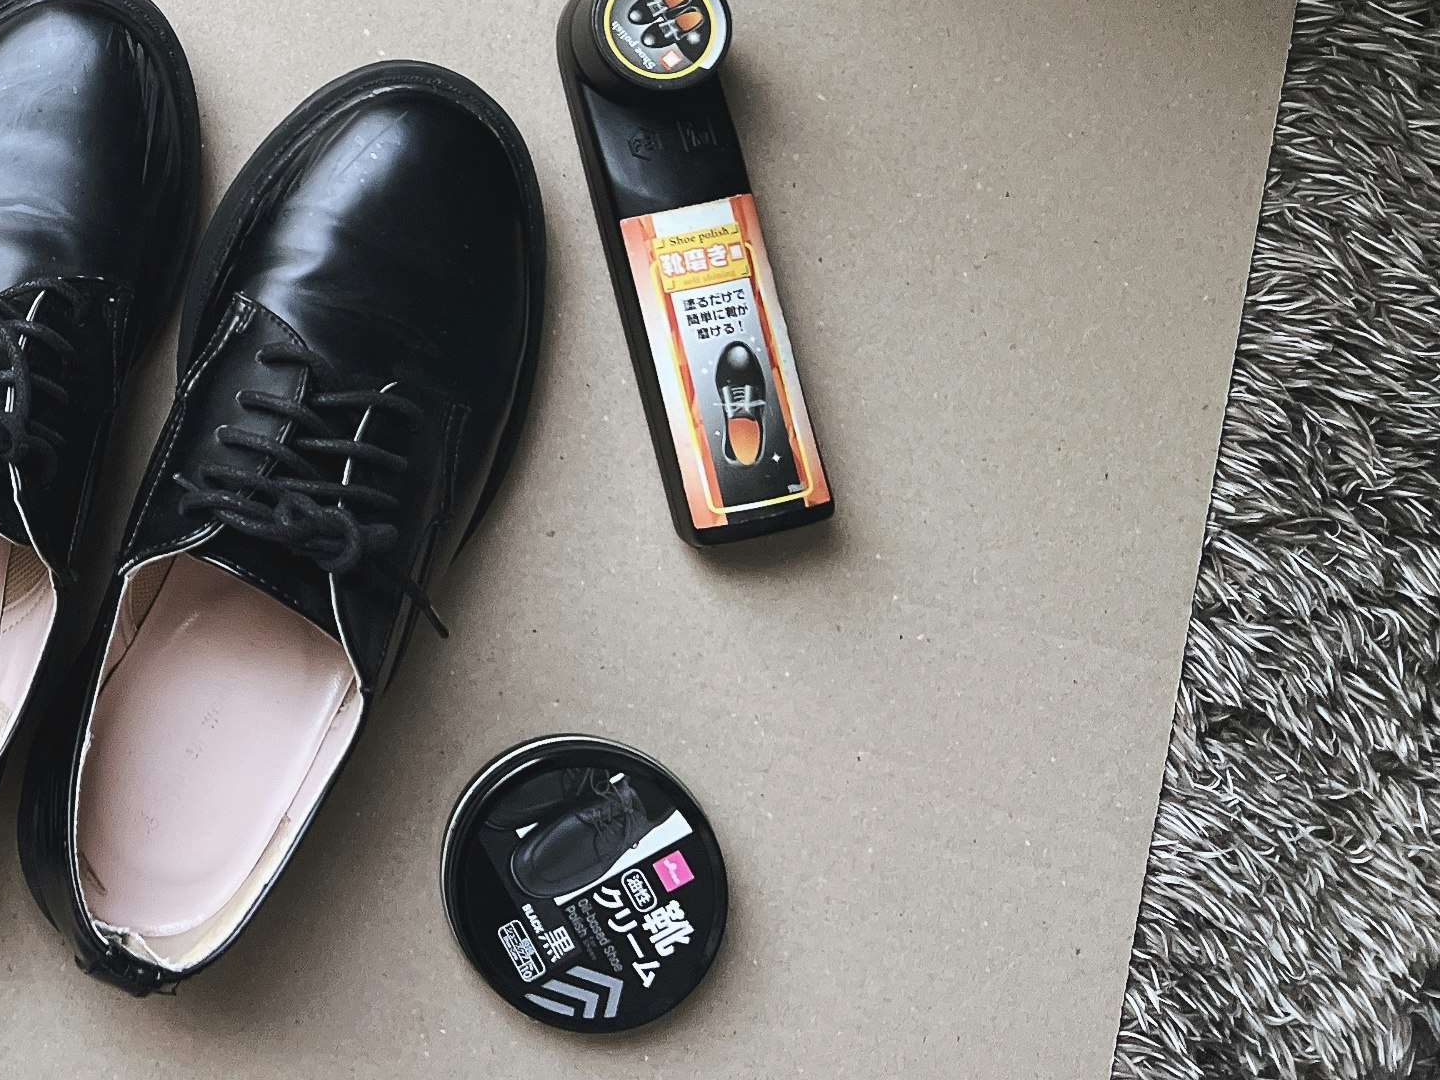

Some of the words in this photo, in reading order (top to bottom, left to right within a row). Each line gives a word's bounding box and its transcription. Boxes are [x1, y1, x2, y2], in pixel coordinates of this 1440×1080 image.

[611, 20, 639, 49] polish
[635, 47, 656, 70] Shoe
[669, 235, 696, 247] Shoe
[698, 227, 730, 243] polish
[521, 903, 544, 934] BLACK
[642, 899, 694, 957] 靴
[539, 925, 576, 963] 黒
[593, 886, 660, 989] クリーム
[602, 943, 624, 973] Shoe
